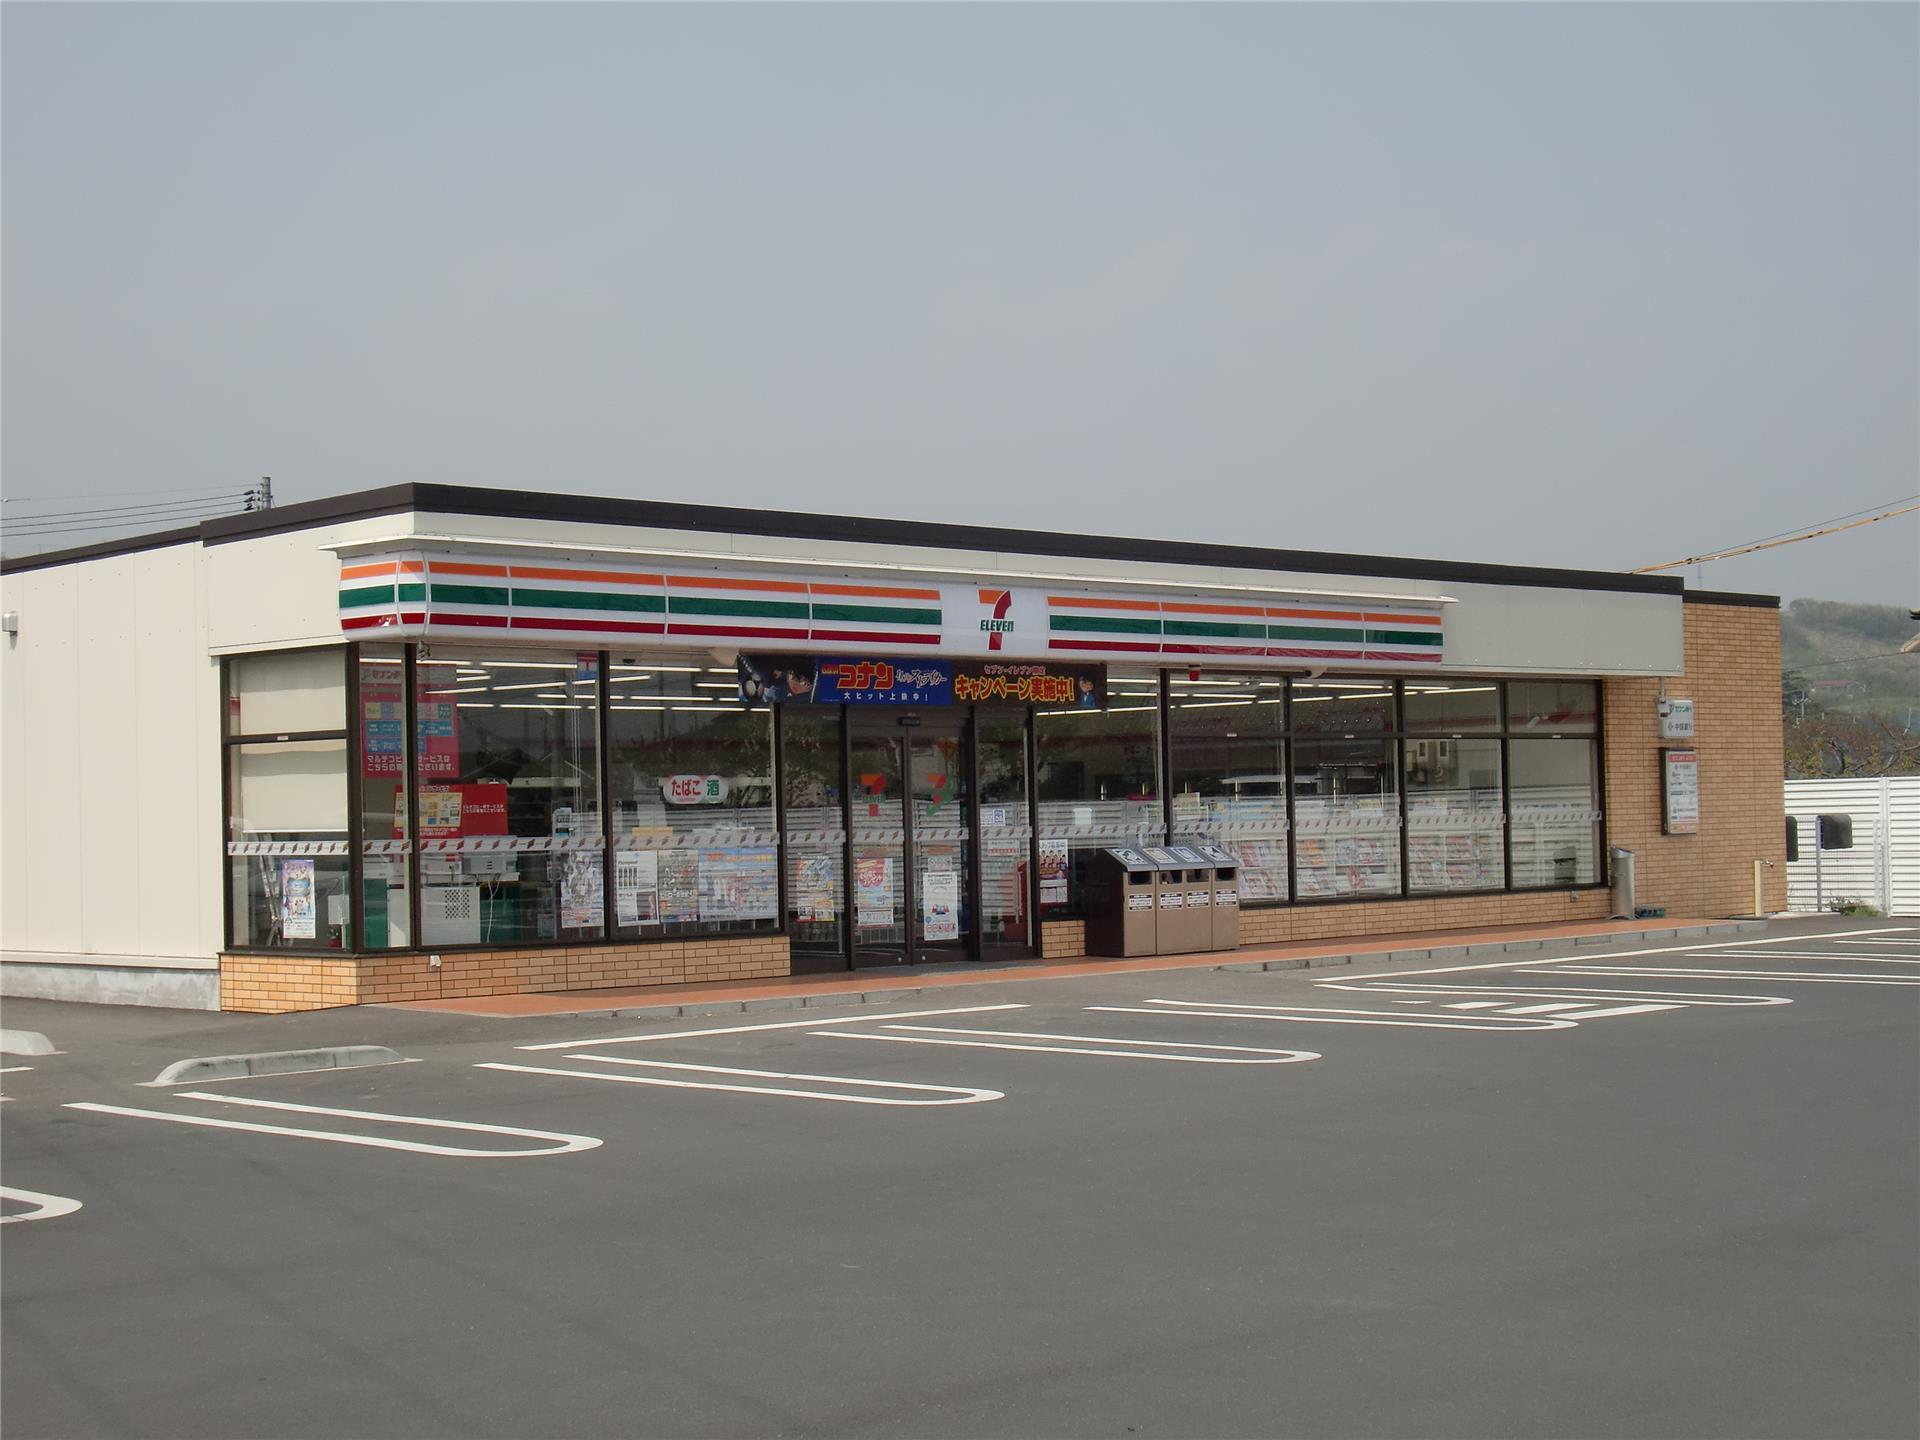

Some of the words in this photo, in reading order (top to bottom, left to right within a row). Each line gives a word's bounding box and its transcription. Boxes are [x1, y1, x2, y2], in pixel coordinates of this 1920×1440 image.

[978, 589, 1012, 651] 7
[836, 661, 895, 690] コナン
[955, 674, 1075, 702] キャンペーン実施中!
[672, 779, 702, 796] たばこ
[707, 779, 720, 796] 酒
